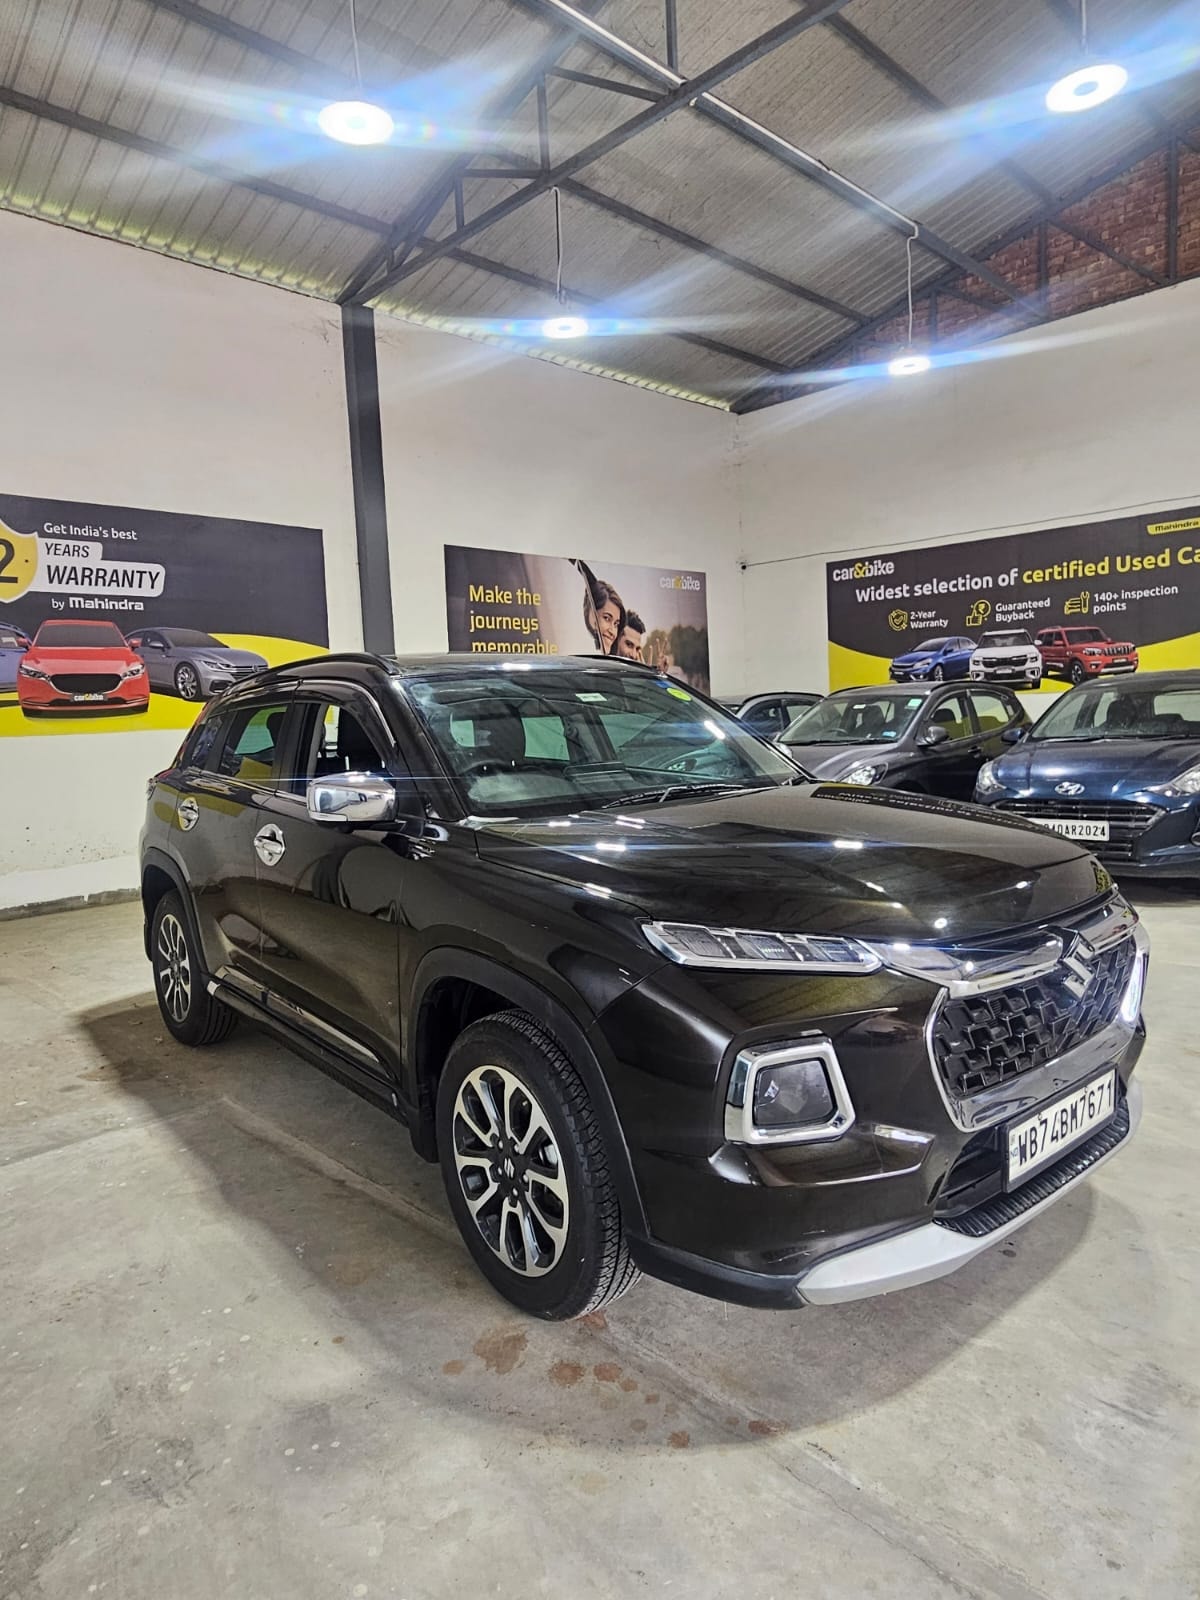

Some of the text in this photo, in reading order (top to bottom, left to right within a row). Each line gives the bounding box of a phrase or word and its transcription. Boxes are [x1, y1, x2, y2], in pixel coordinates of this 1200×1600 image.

[43, 522, 138, 541] Get India's best
[44, 542, 90, 558] YEARS
[46, 564, 161, 590] WARRANTY
[832, 560, 895, 582] car&bike
[856, 583, 910, 603] Widest
[913, 574, 993, 597] selection
[998, 568, 1018, 587] of
[1022, 556, 1109, 584] certified
[1115, 548, 1171, 573] Used
[469, 585, 541, 606] Make the
[1093, 585, 1179, 602] 140+ inspection
[51, 598, 65, 610] by
[995, 598, 1051, 612] Guaranteed
[1093, 602, 1127, 615] points
[469, 610, 539, 634] journeys
[910, 610, 936, 619] 2-Year
[995, 611, 1035, 623] Buyback
[910, 618, 949, 629] Warranty
[472, 639, 558, 655] memorable
[1018, 1080, 1113, 1166] WB74BM7671
